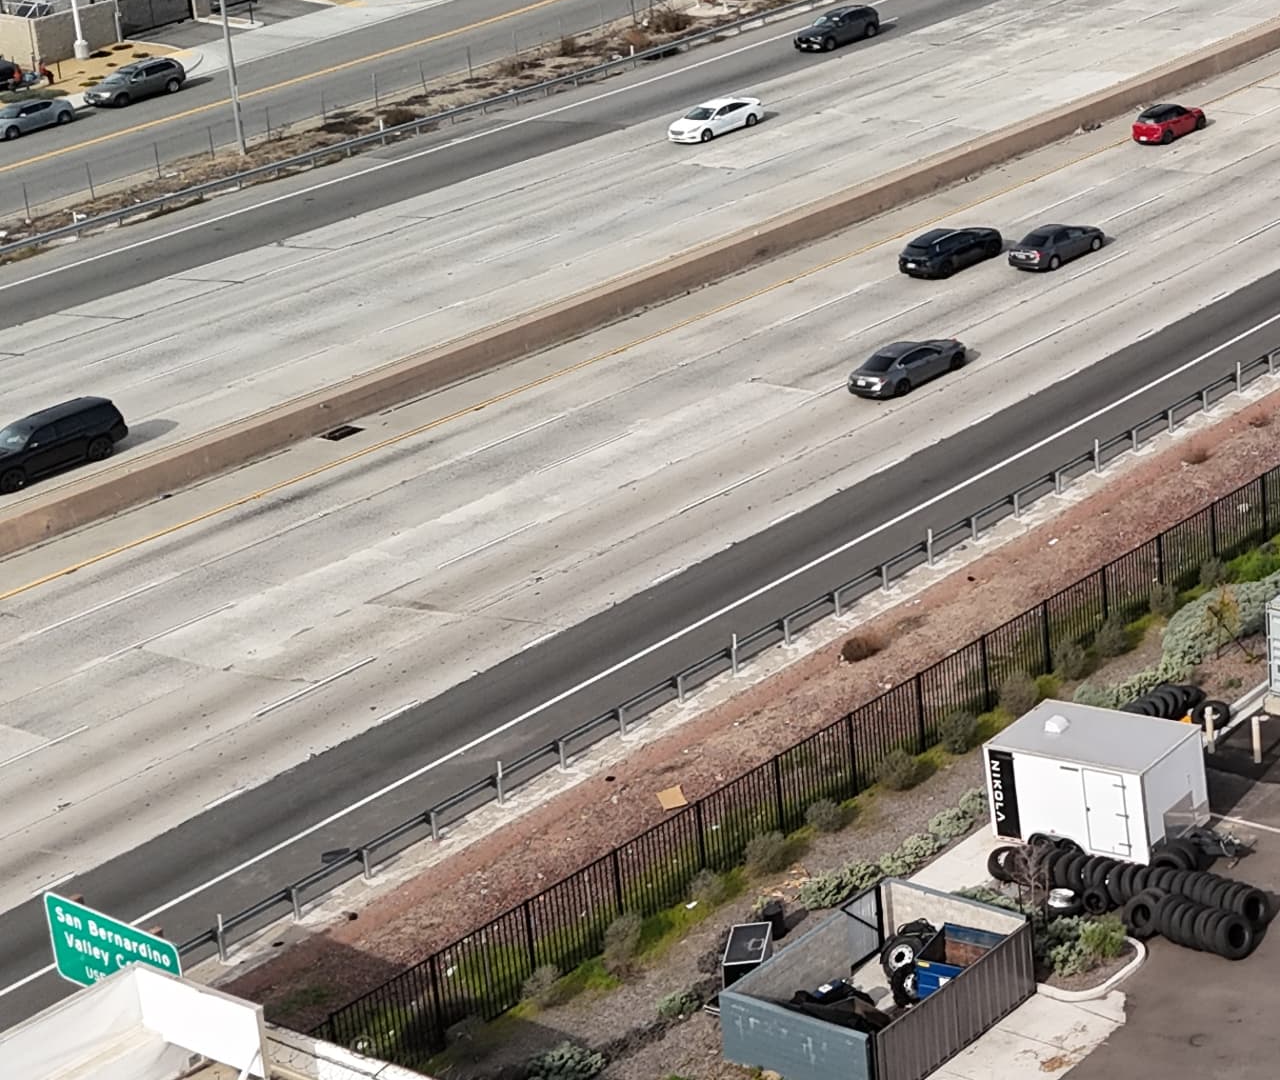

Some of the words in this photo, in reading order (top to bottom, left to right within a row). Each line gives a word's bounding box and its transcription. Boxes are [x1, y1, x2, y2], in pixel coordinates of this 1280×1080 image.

[990, 759, 1006, 822] NIKOLA
[55, 906, 82, 931] San
[88, 920, 171, 967] Bernardino
[64, 930, 109, 967] Valley
